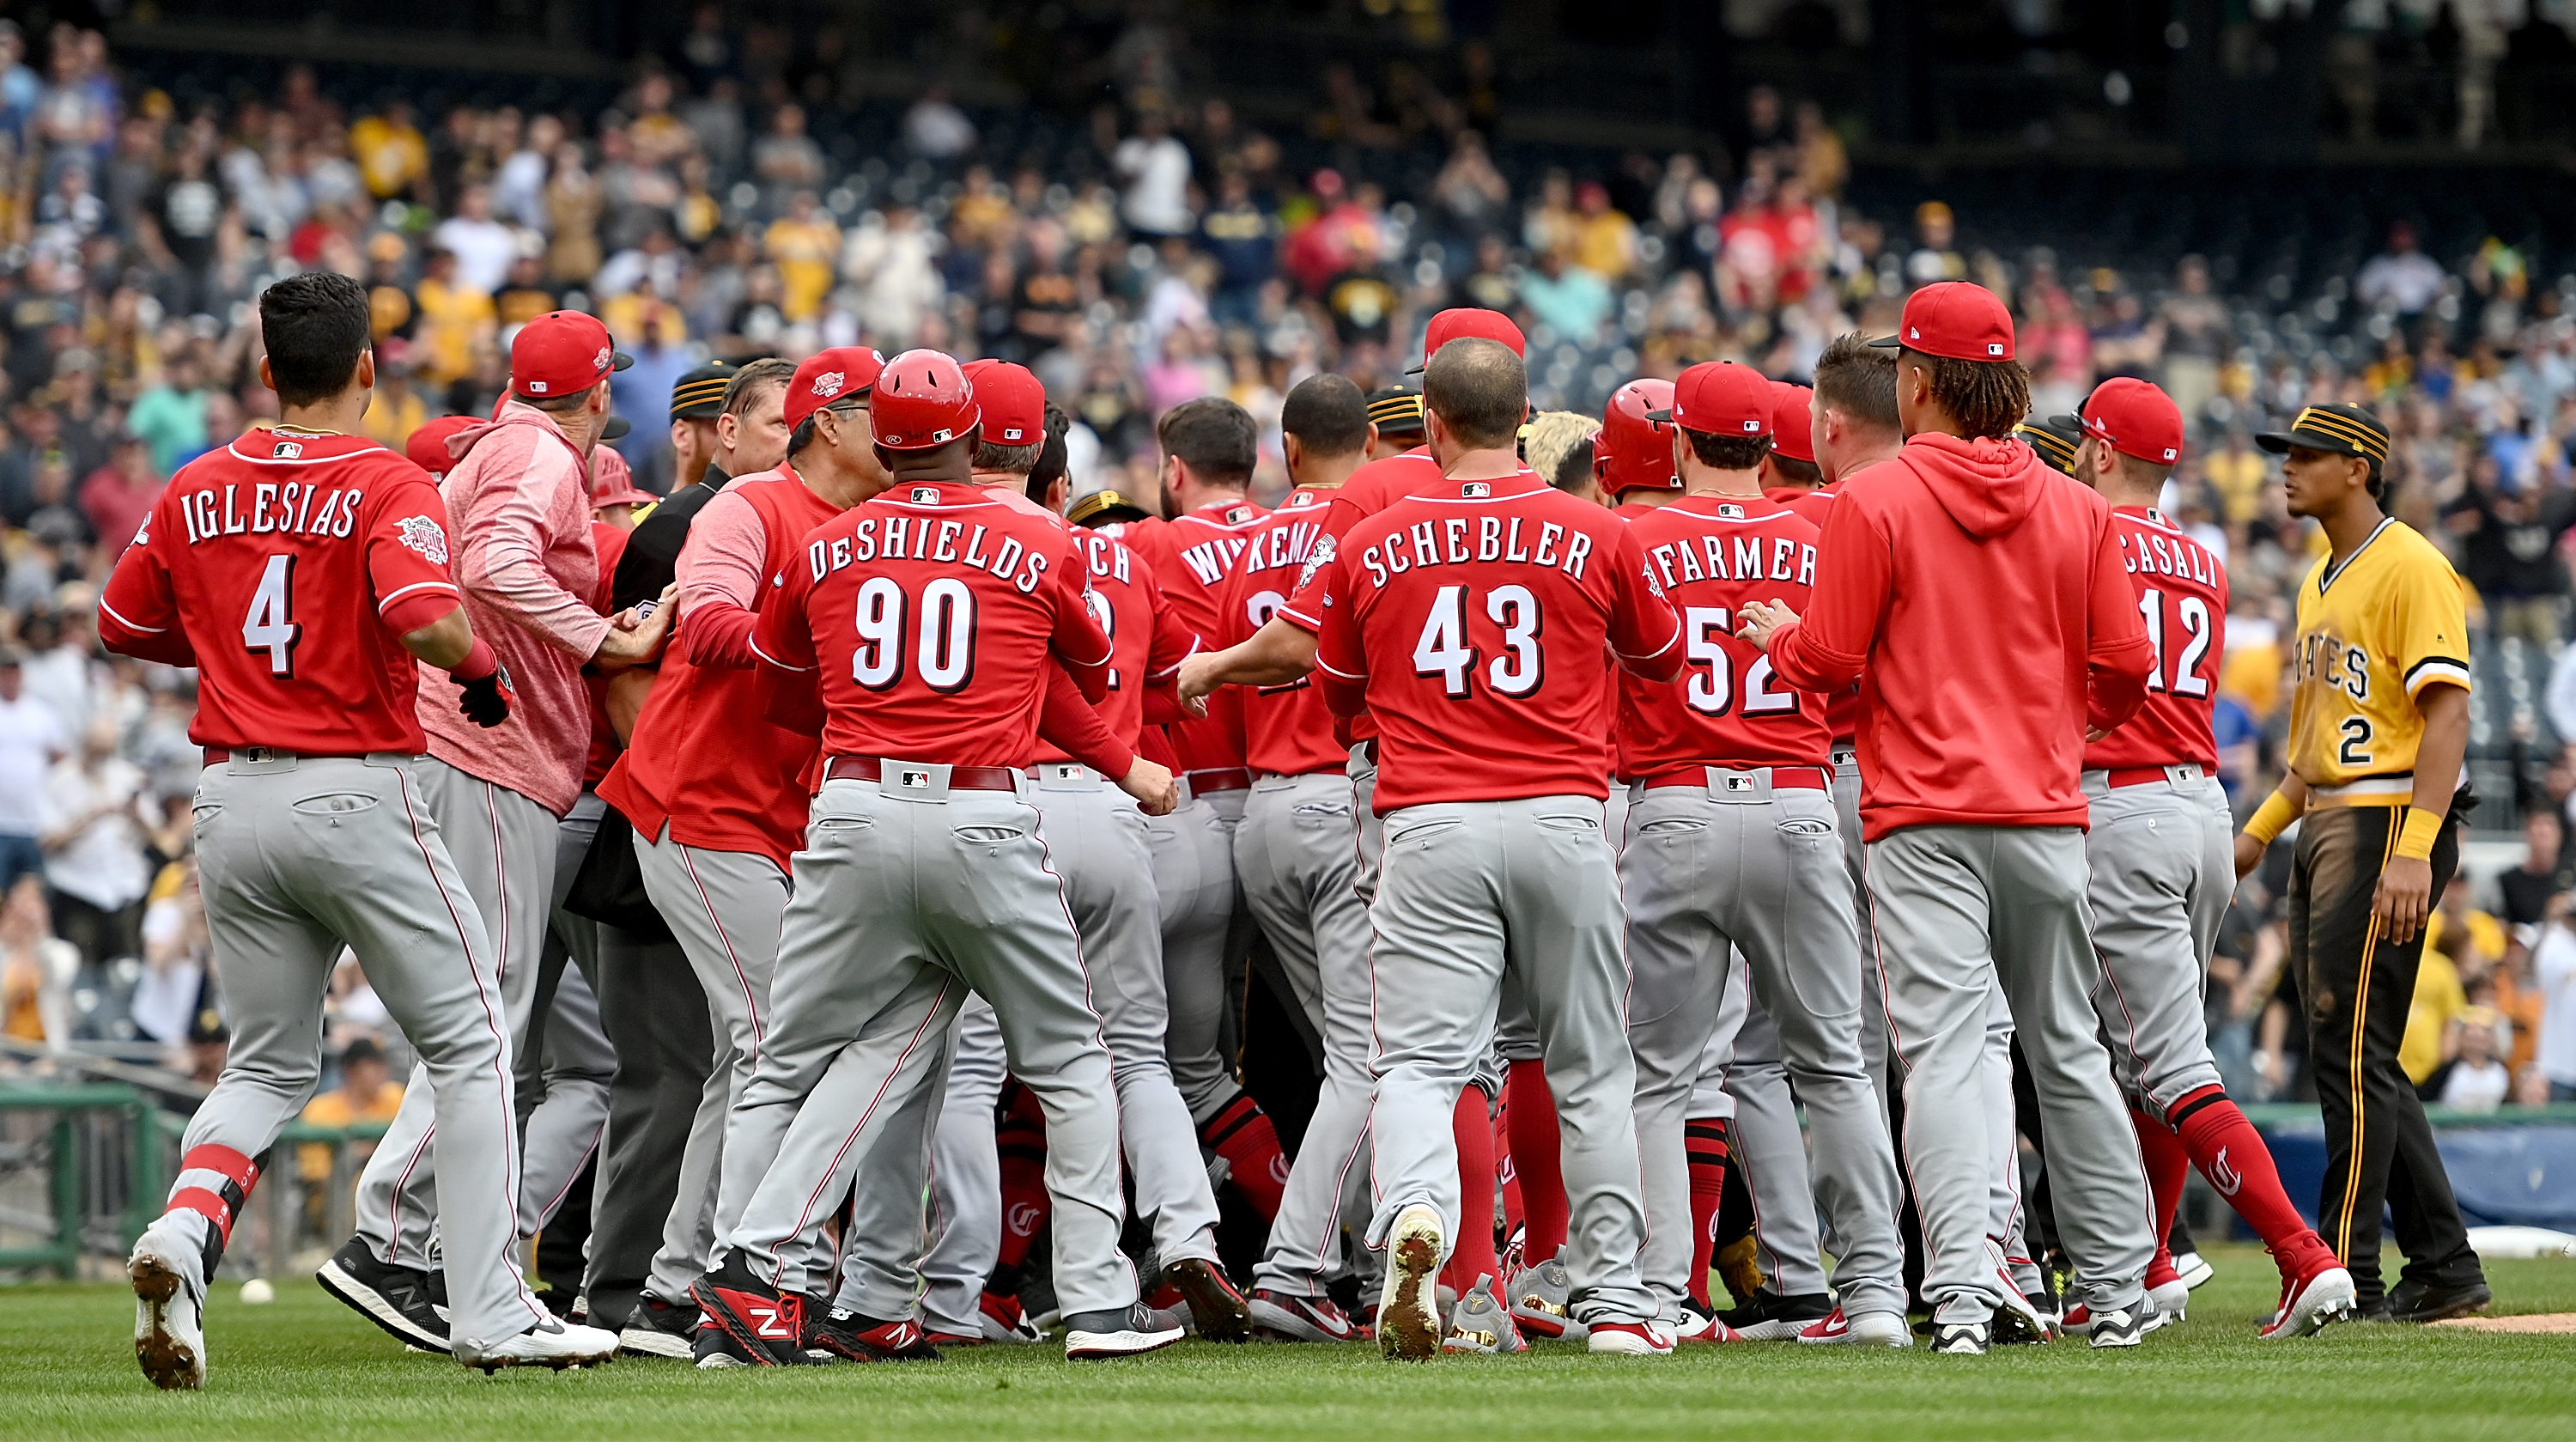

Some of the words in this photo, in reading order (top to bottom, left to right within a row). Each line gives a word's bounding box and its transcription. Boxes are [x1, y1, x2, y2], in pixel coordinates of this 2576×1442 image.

[180, 482, 364, 545] IGLESIAS
[1099, 490, 1120, 509] P
[1363, 516, 1592, 588] SCHEBLER
[1651, 535, 1817, 590] FARMER
[241, 552, 303, 678] 4
[851, 576, 978, 694] 90
[1412, 584, 1543, 699] 43
[2139, 588, 2212, 700] 12
[1683, 605, 1801, 719] 52
[2339, 715, 2373, 765] 2
